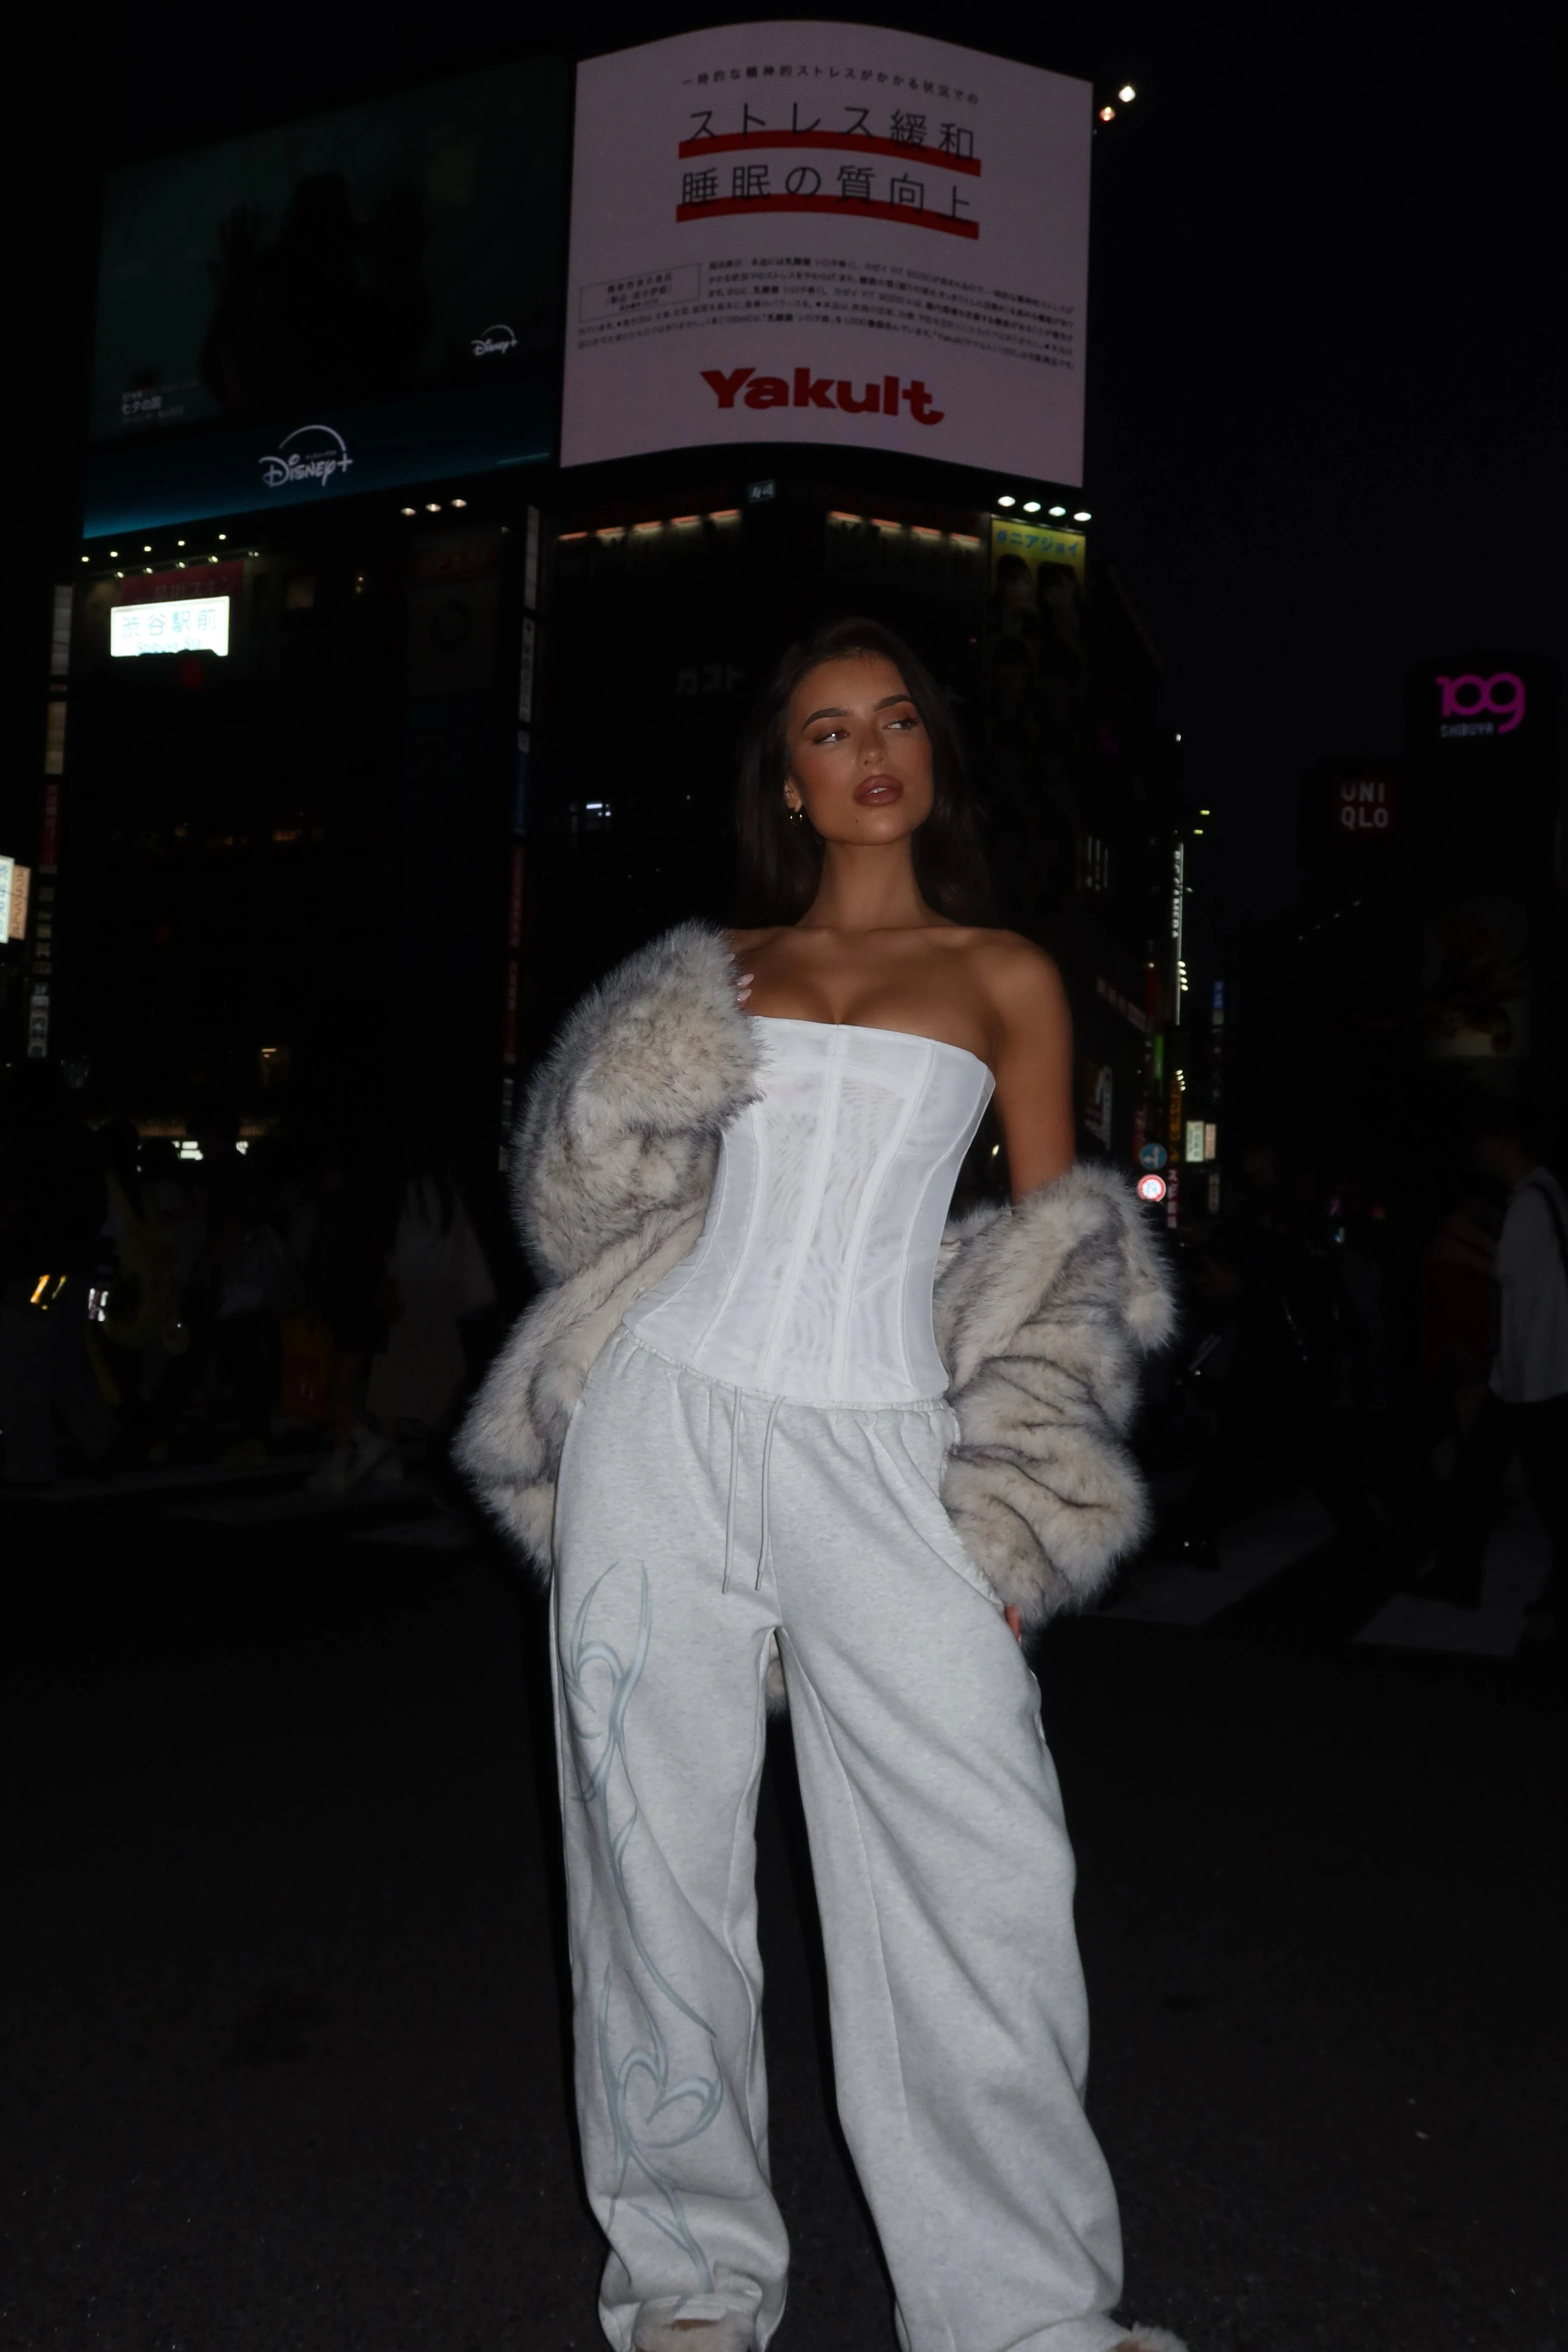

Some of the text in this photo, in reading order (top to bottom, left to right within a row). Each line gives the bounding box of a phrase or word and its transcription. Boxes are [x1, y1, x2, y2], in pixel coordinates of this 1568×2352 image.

[687, 102, 974, 161] ストレス緩和
[682, 164, 974, 224] 睡眠の質向上
[700, 368, 944, 425] Yakult
[122, 608, 216, 639] 渋谷駅前
[1433, 671, 1527, 735] 109
[1340, 781, 1385, 803] UNI
[1340, 805, 1389, 831] QLO
